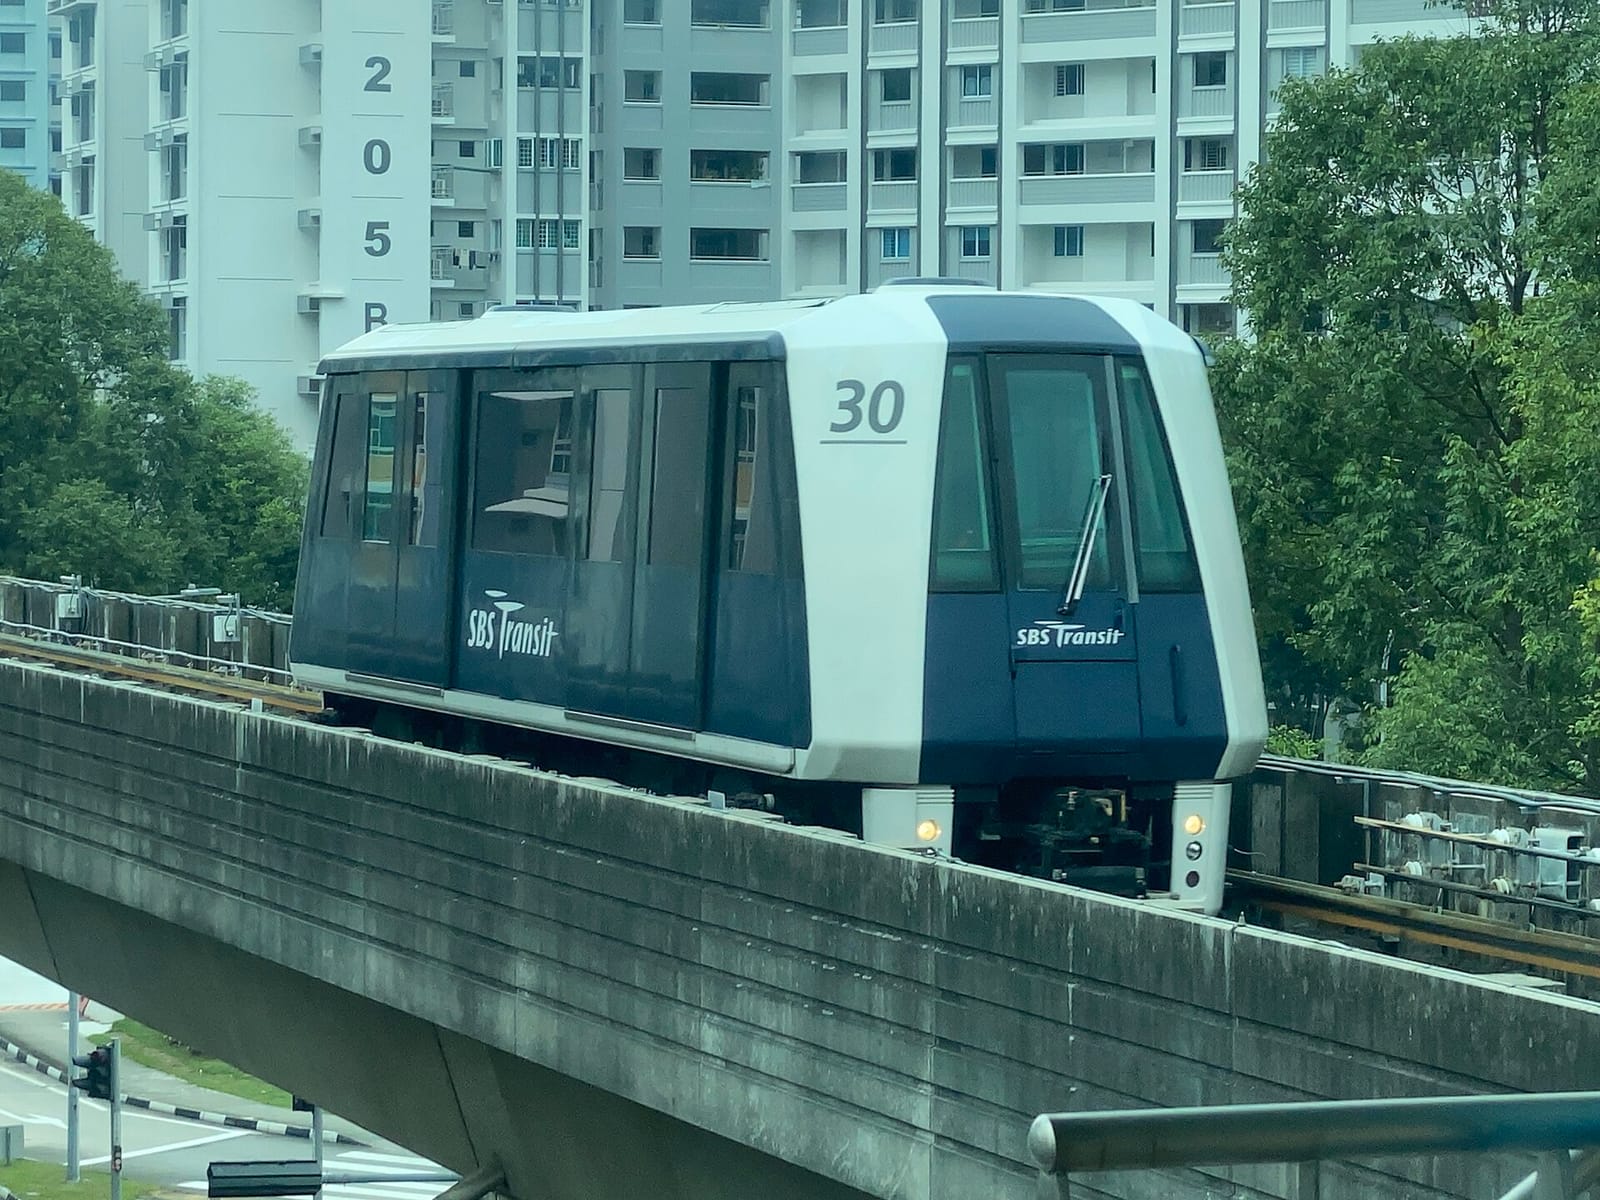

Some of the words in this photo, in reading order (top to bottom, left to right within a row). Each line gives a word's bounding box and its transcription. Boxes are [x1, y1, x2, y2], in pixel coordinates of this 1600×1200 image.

[829, 379, 905, 434] 30
[467, 609, 496, 650] SBS
[494, 601, 560, 660] Transit
[1016, 628, 1051, 646] SBS
[1046, 624, 1125, 649] Transit
